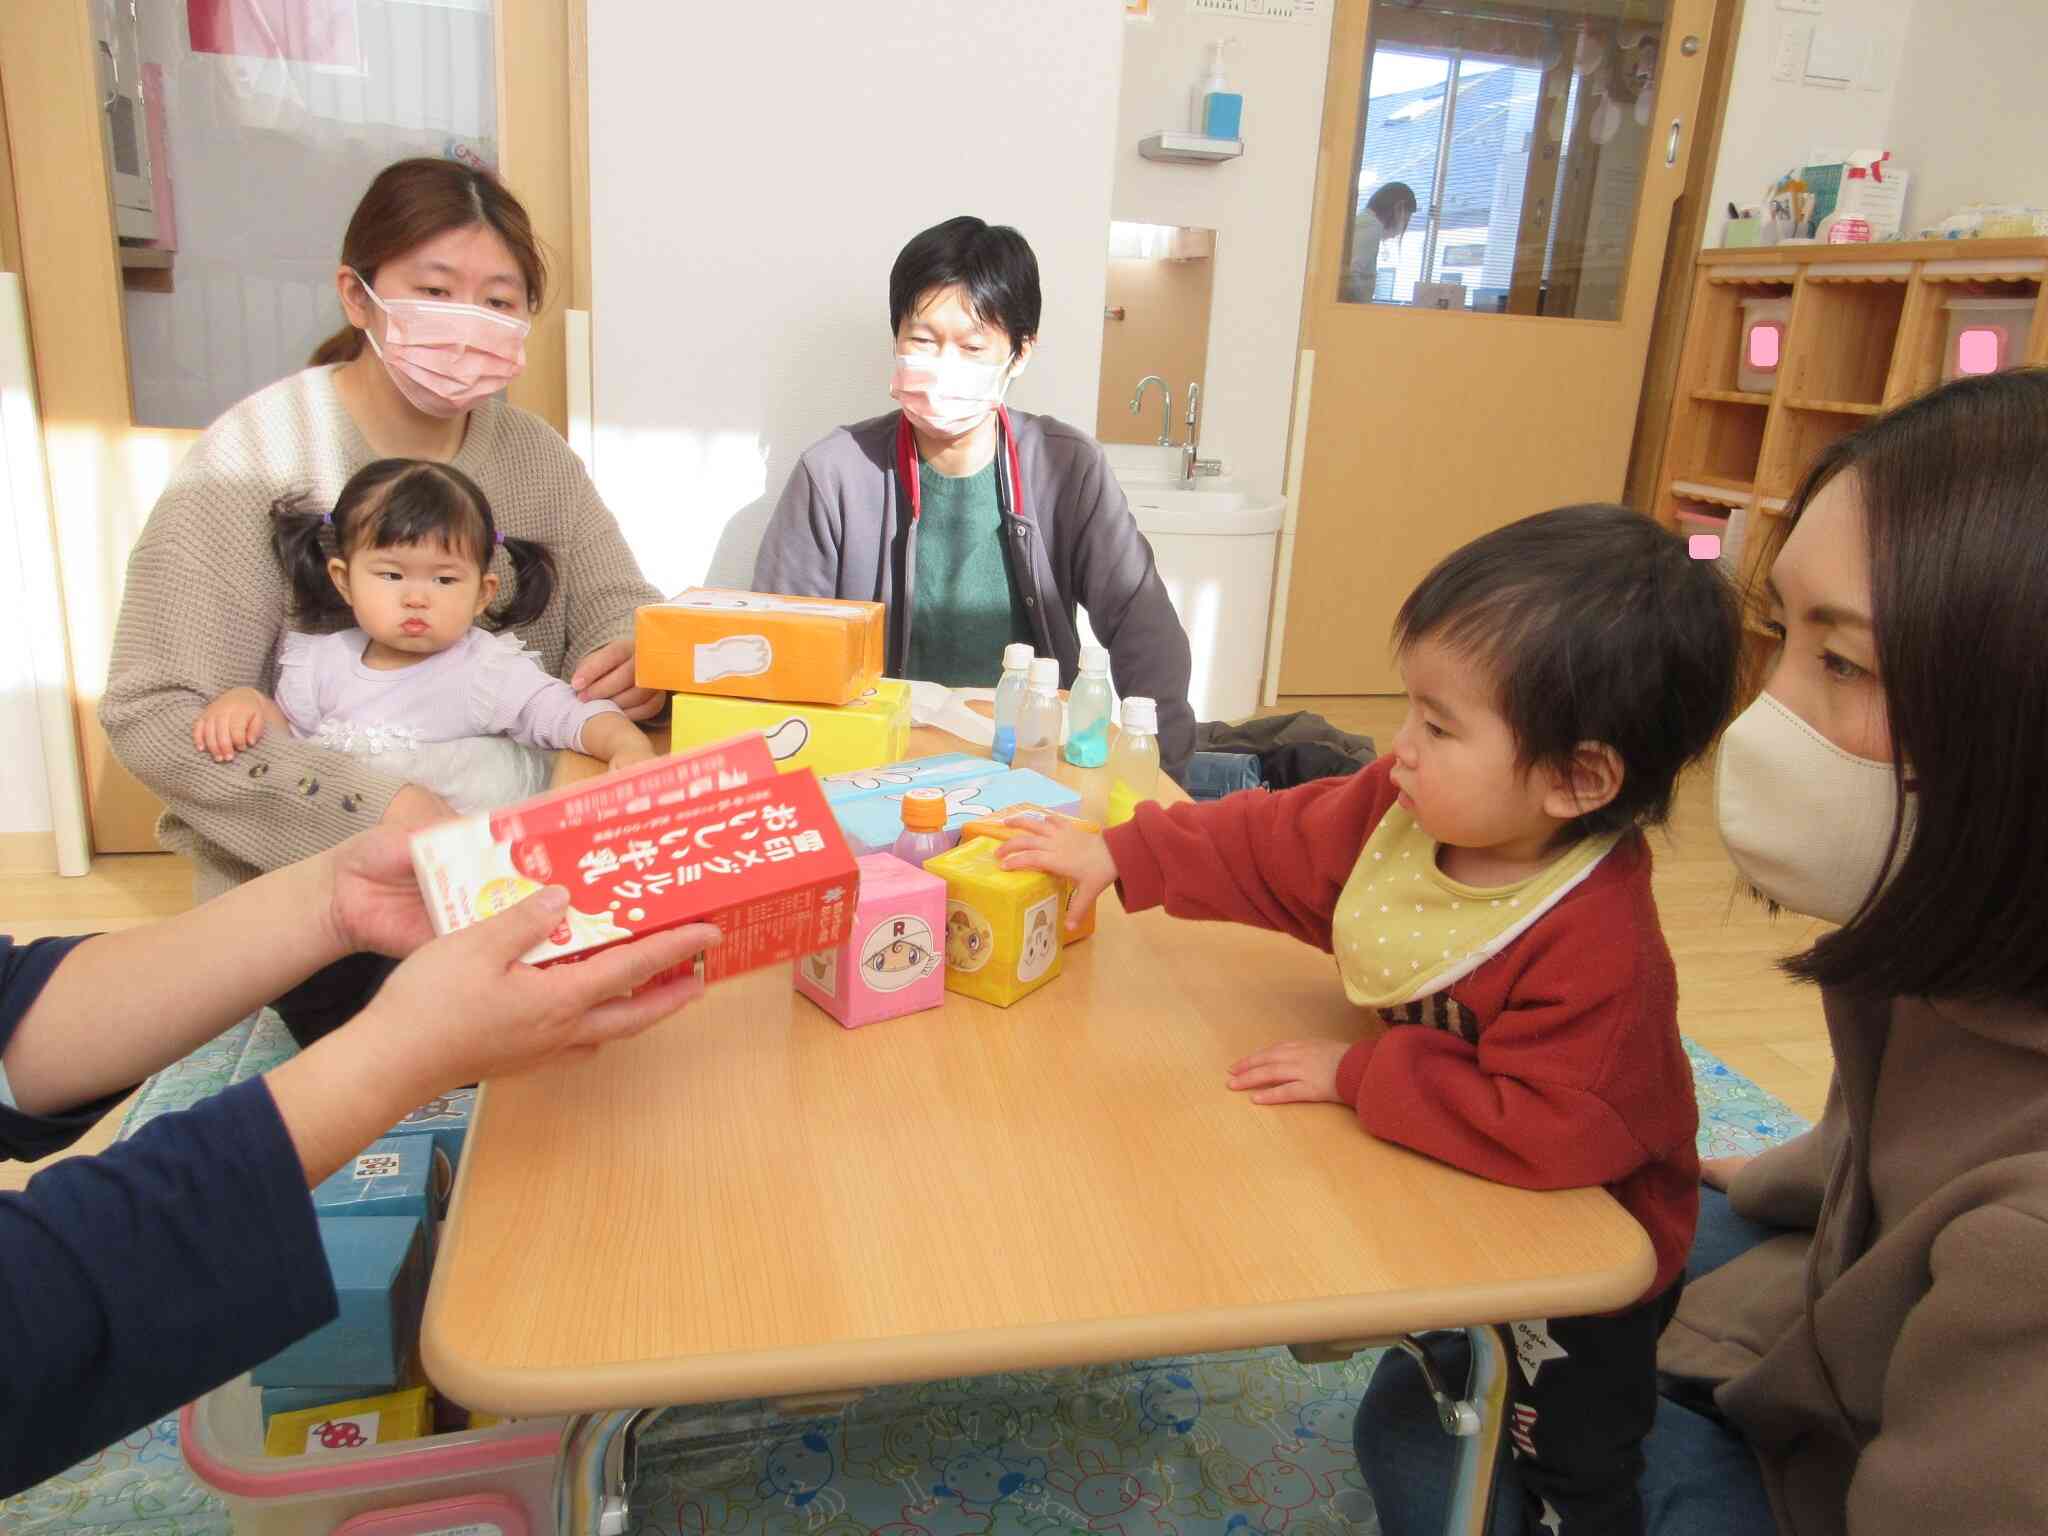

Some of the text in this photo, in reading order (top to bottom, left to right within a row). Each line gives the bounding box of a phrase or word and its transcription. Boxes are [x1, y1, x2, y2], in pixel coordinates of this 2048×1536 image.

[577, 802, 799, 885] おいしい牛乳
[611, 829, 826, 899] 雪印メグミルク
[893, 921, 905, 937] R
